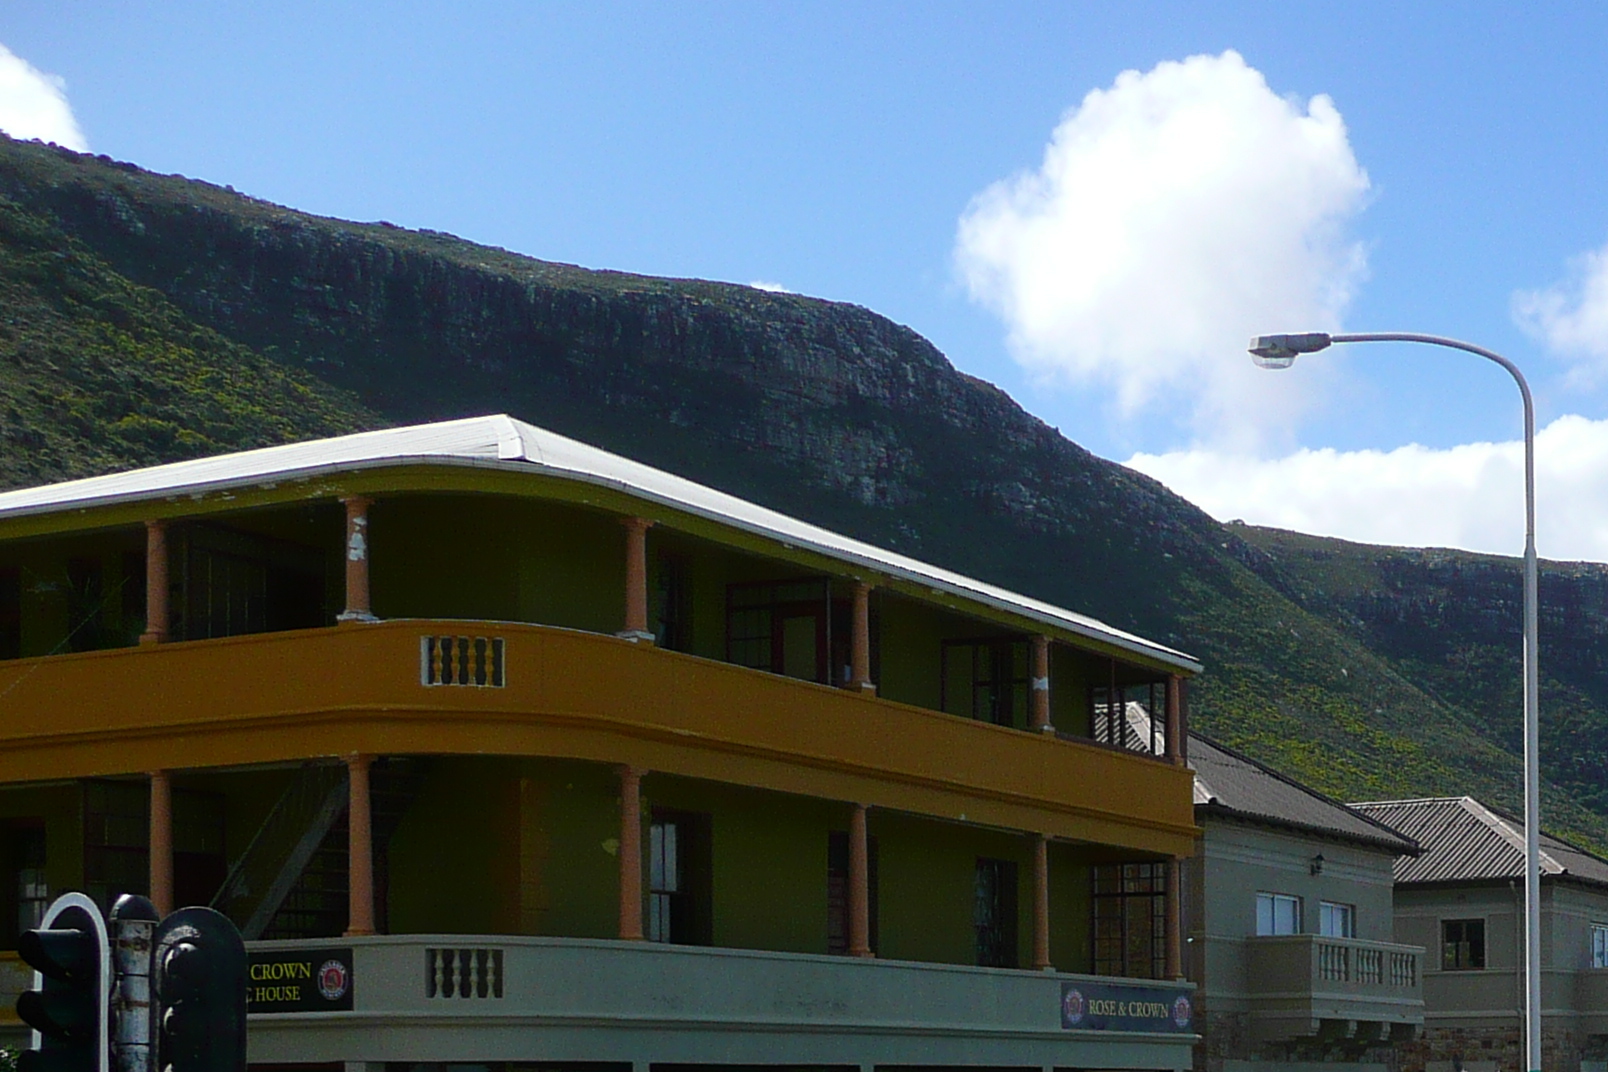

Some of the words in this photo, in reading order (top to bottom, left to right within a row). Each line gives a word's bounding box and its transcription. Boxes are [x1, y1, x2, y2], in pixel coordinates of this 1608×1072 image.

[250, 962, 312, 981] CROWN
[255, 986, 301, 1002] HOUSE
[1088, 999, 1117, 1016] ROSE
[1117, 1003, 1127, 1017] &
[1128, 1001, 1169, 1019] CROWN
